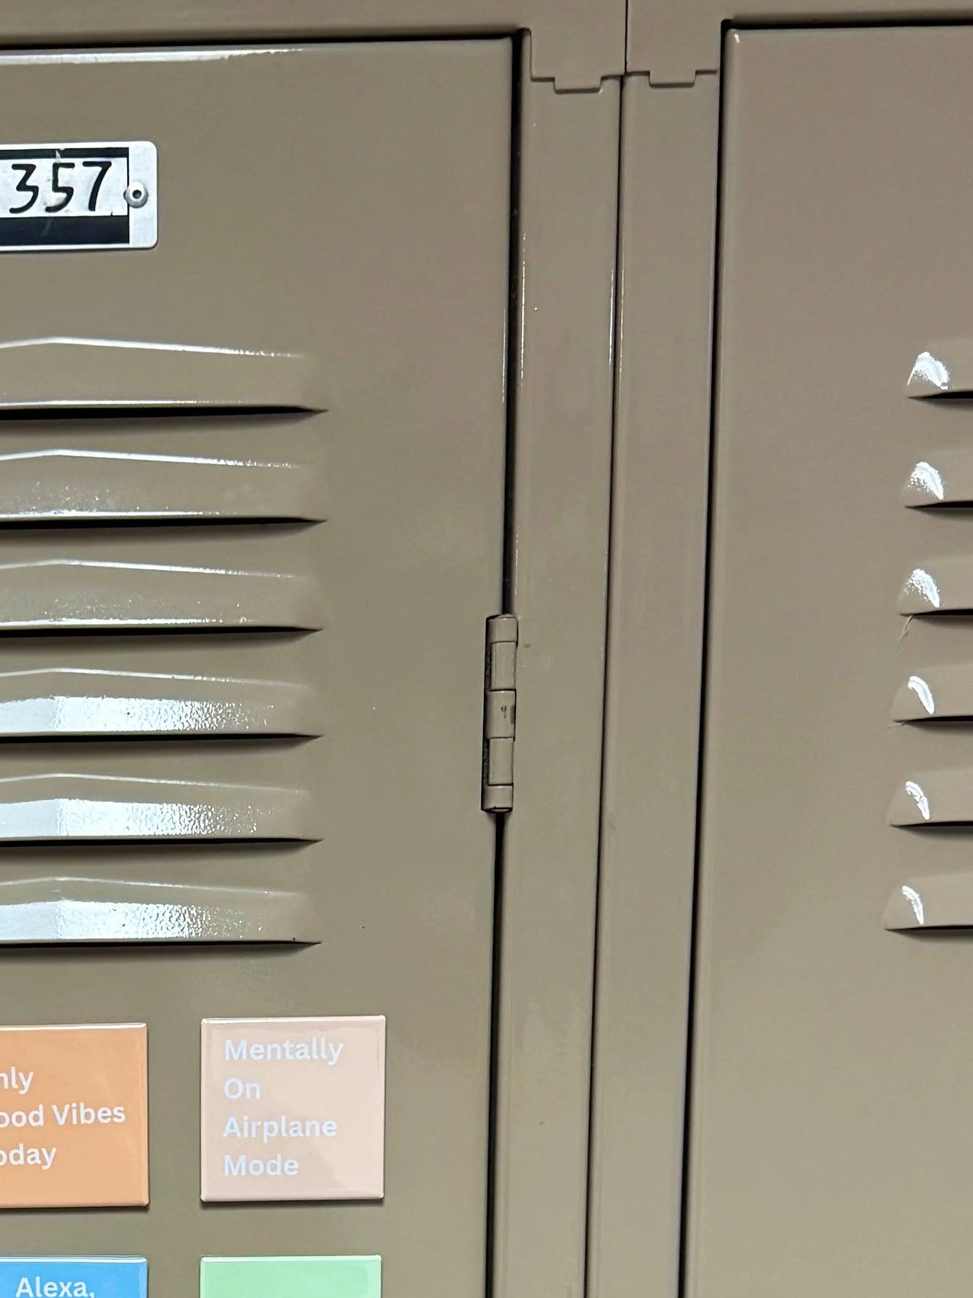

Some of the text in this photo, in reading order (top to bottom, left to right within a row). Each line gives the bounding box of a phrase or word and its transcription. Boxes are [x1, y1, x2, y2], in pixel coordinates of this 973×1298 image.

[225, 1038, 343, 1065] Mentally
[224, 1078, 260, 1099] On
[52, 1102, 125, 1125] Vibes
[223, 1115, 337, 1143] Airplane
[225, 1154, 298, 1176] Mode
